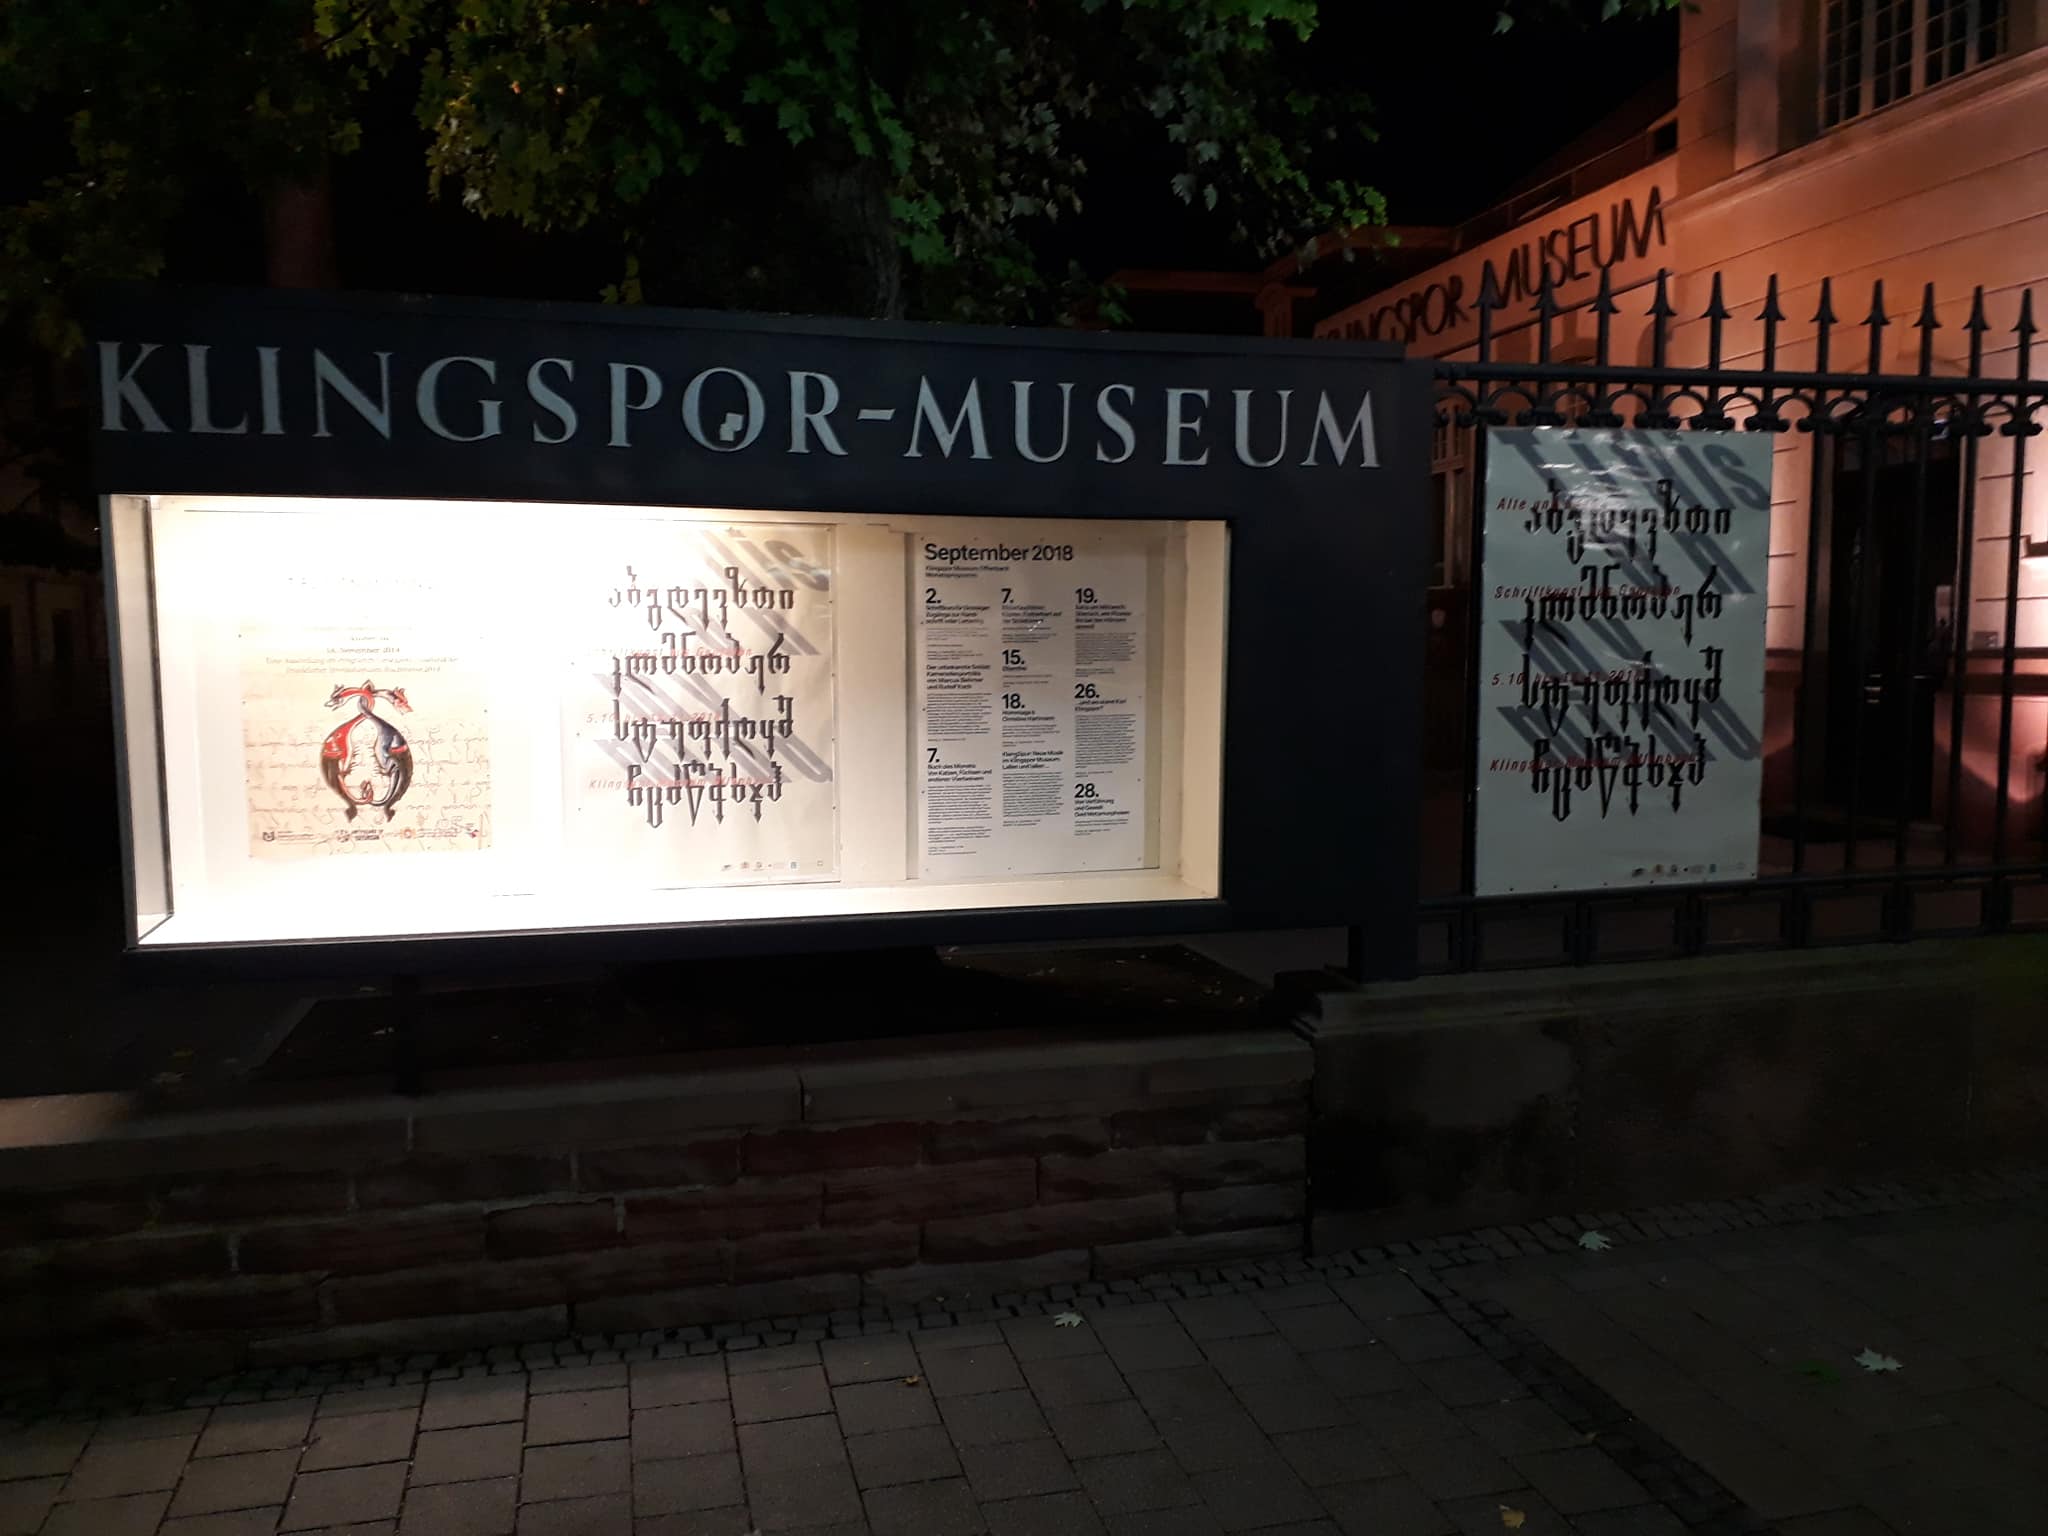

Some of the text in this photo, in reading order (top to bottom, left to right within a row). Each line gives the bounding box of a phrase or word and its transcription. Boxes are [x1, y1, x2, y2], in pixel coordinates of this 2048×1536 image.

[1316, 185, 1667, 342] INGSPOR MUSEUM
[98, 340, 1381, 468] KLINGSPOR-MUSEUM
[1496, 497, 1528, 511] Alte
[925, 543, 1073, 565] September 2018
[925, 588, 942, 604] 2.
[1002, 588, 1014, 604] 7.
[1075, 588, 1098, 604] 19.
[1002, 649, 1025, 665] 15.
[1074, 683, 1100, 699] 26.
[1002, 693, 1025, 709] 18.
[927, 747, 940, 763] 7.
[1074, 783, 1099, 798] 28.
